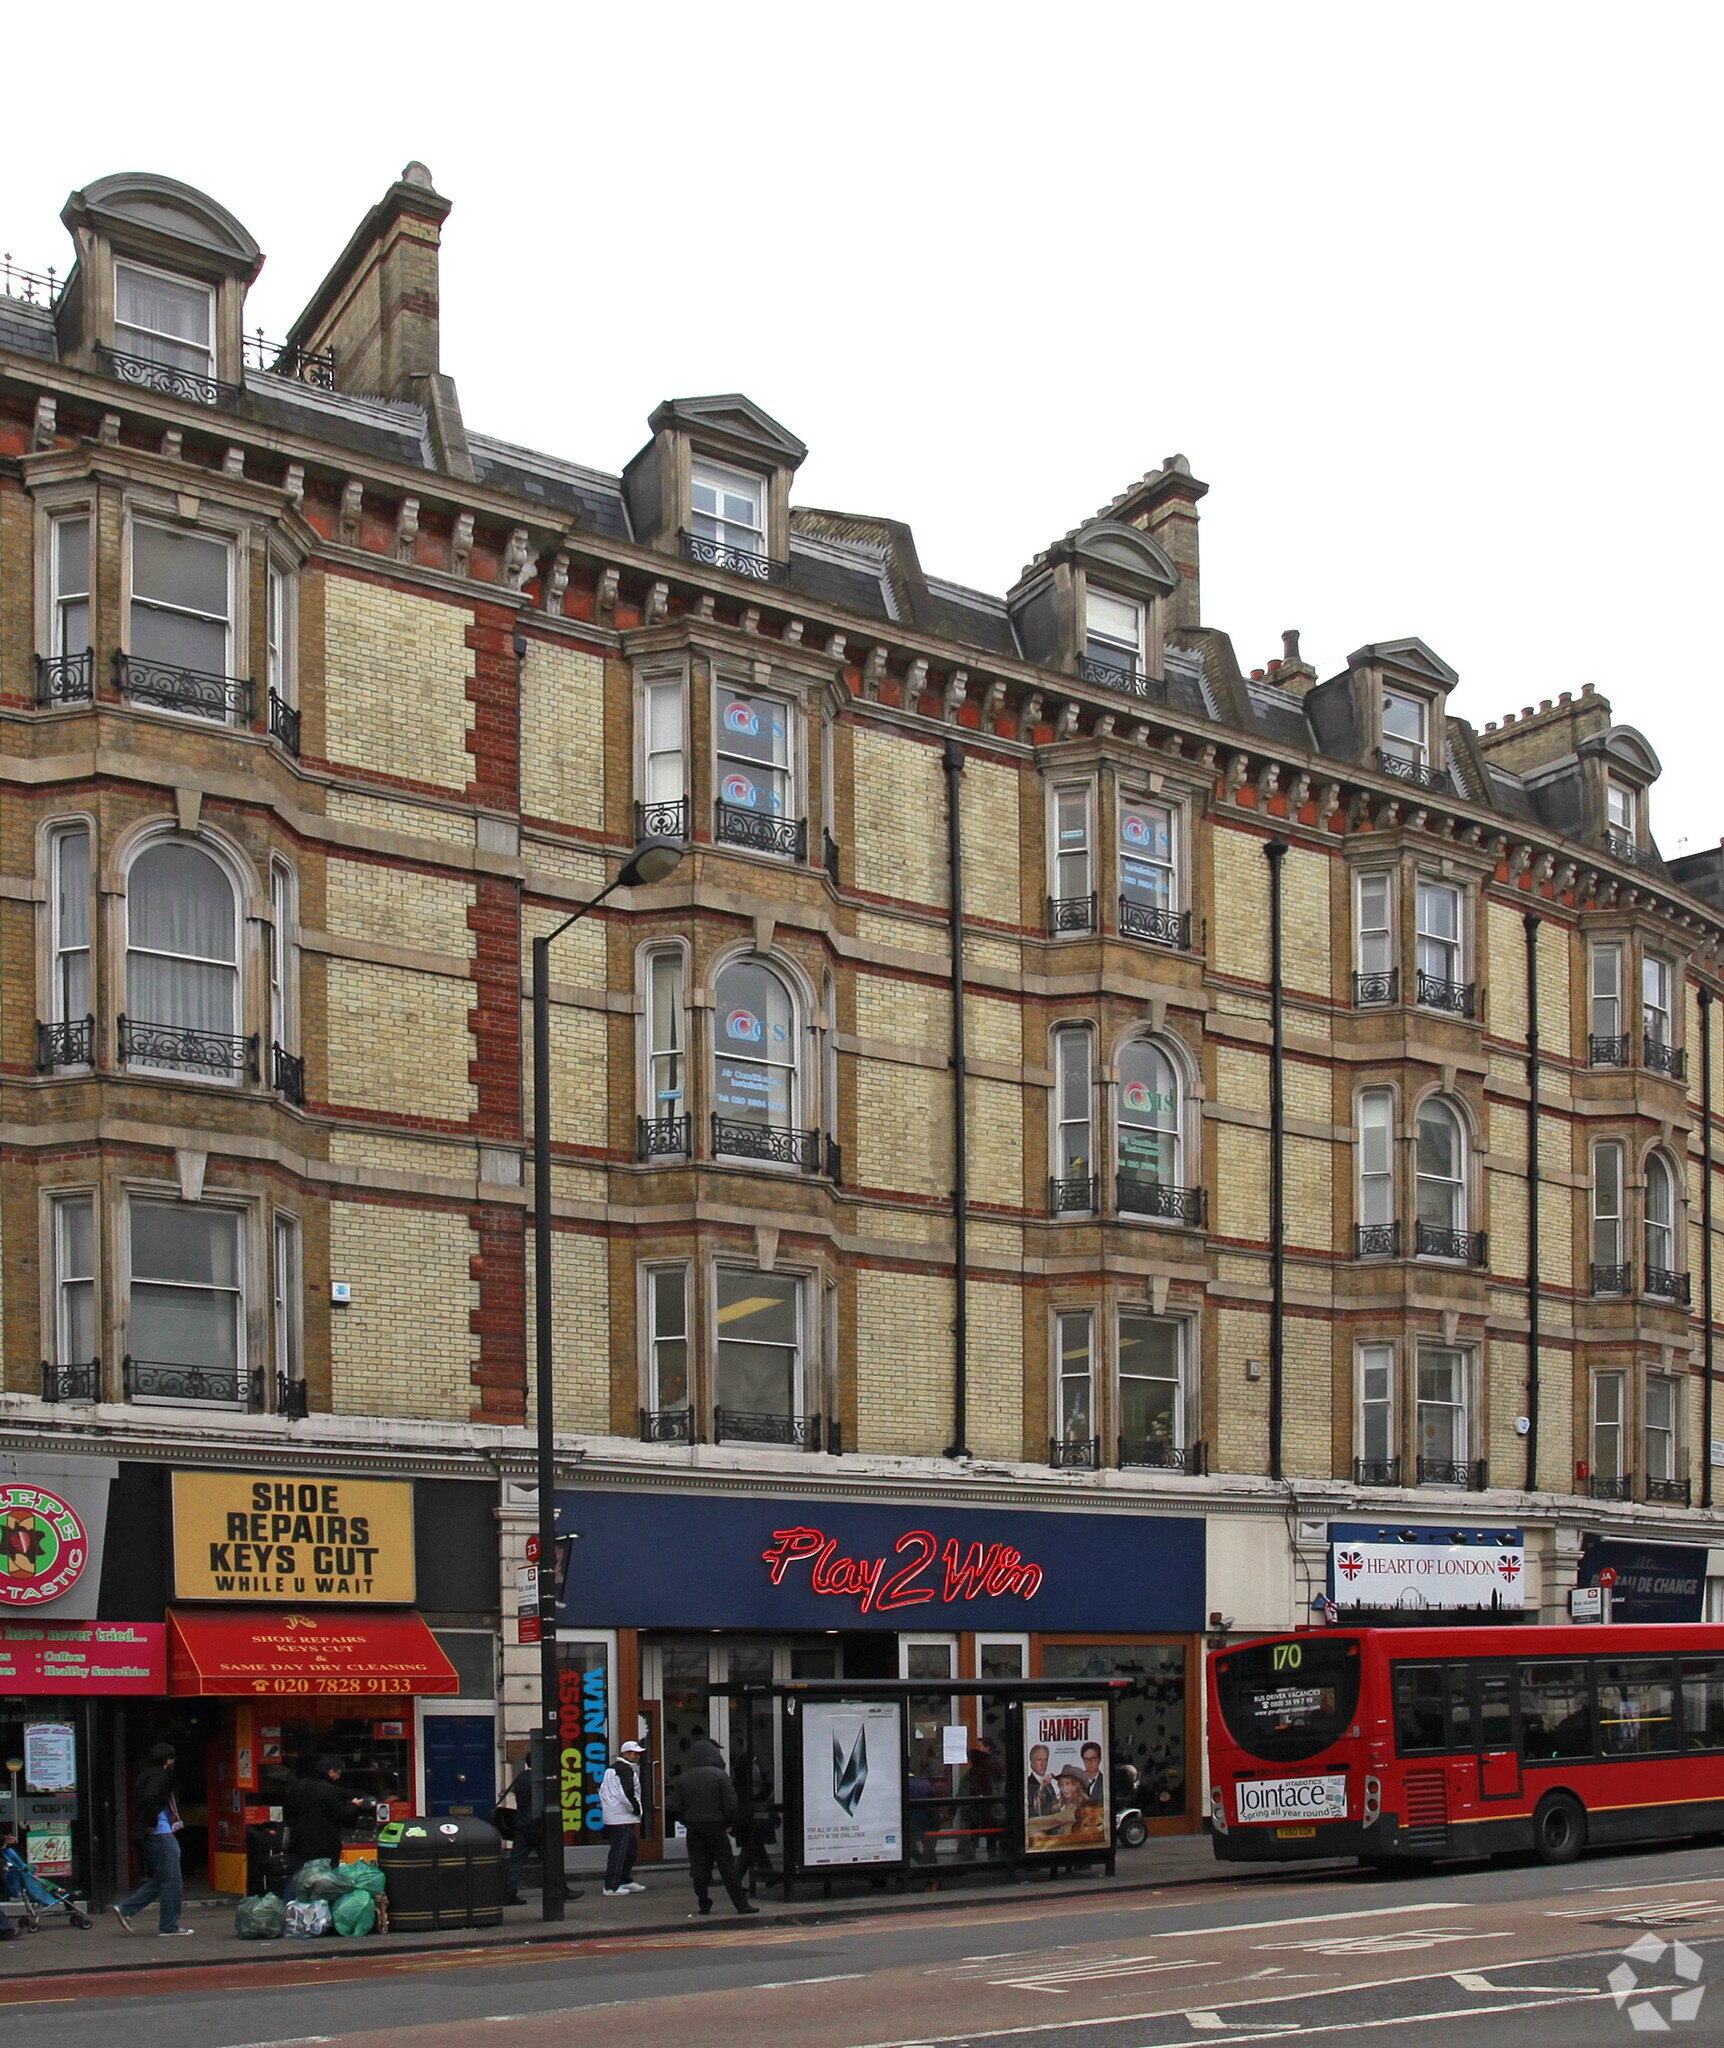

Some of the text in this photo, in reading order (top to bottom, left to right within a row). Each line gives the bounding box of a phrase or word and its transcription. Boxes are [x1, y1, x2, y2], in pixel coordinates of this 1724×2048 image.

[252, 1482, 340, 1514] SHOE
[226, 1512, 370, 1545] REPAIRS
[209, 1543, 380, 1576] KEYS CUT
[1367, 1558, 1497, 1576] HEART OF LONDON
[762, 1527, 1043, 1613] Play 2 Win
[215, 1575, 374, 1594] WHILE U WAIT
[1637, 1576, 1653, 1593] DE
[1653, 1577, 1698, 1595] CHANGE
[5, 1627, 44, 1641] have
[47, 1629, 92, 1642] never
[251, 1635, 367, 1644] SHOE REPAIRS
[276, 1644, 354, 1653] KEYS CUT
[315, 1654, 327, 1662] &
[1273, 1644, 1302, 1671] 170
[220, 1663, 427, 1672] SAME DAY DRY CLEANING
[273, 1678, 412, 1693] 020 7828 9133
[1266, 1692, 1287, 1700] DRIVER
[1287, 1689, 1321, 1698] VACANCIES
[582, 1667, 607, 1738] WIN
[558, 1669, 583, 1832] £500 CASH
[585, 1742, 607, 1784] UP
[1285, 1778, 1322, 1787] VITABIOTICS
[1240, 1781, 1325, 1814] Jointace
[1242, 1809, 1269, 1821] Spring
[1271, 1807, 1280, 1816] all
[1282, 1809, 1301, 1818] year
[1303, 1807, 1329, 1818] round
